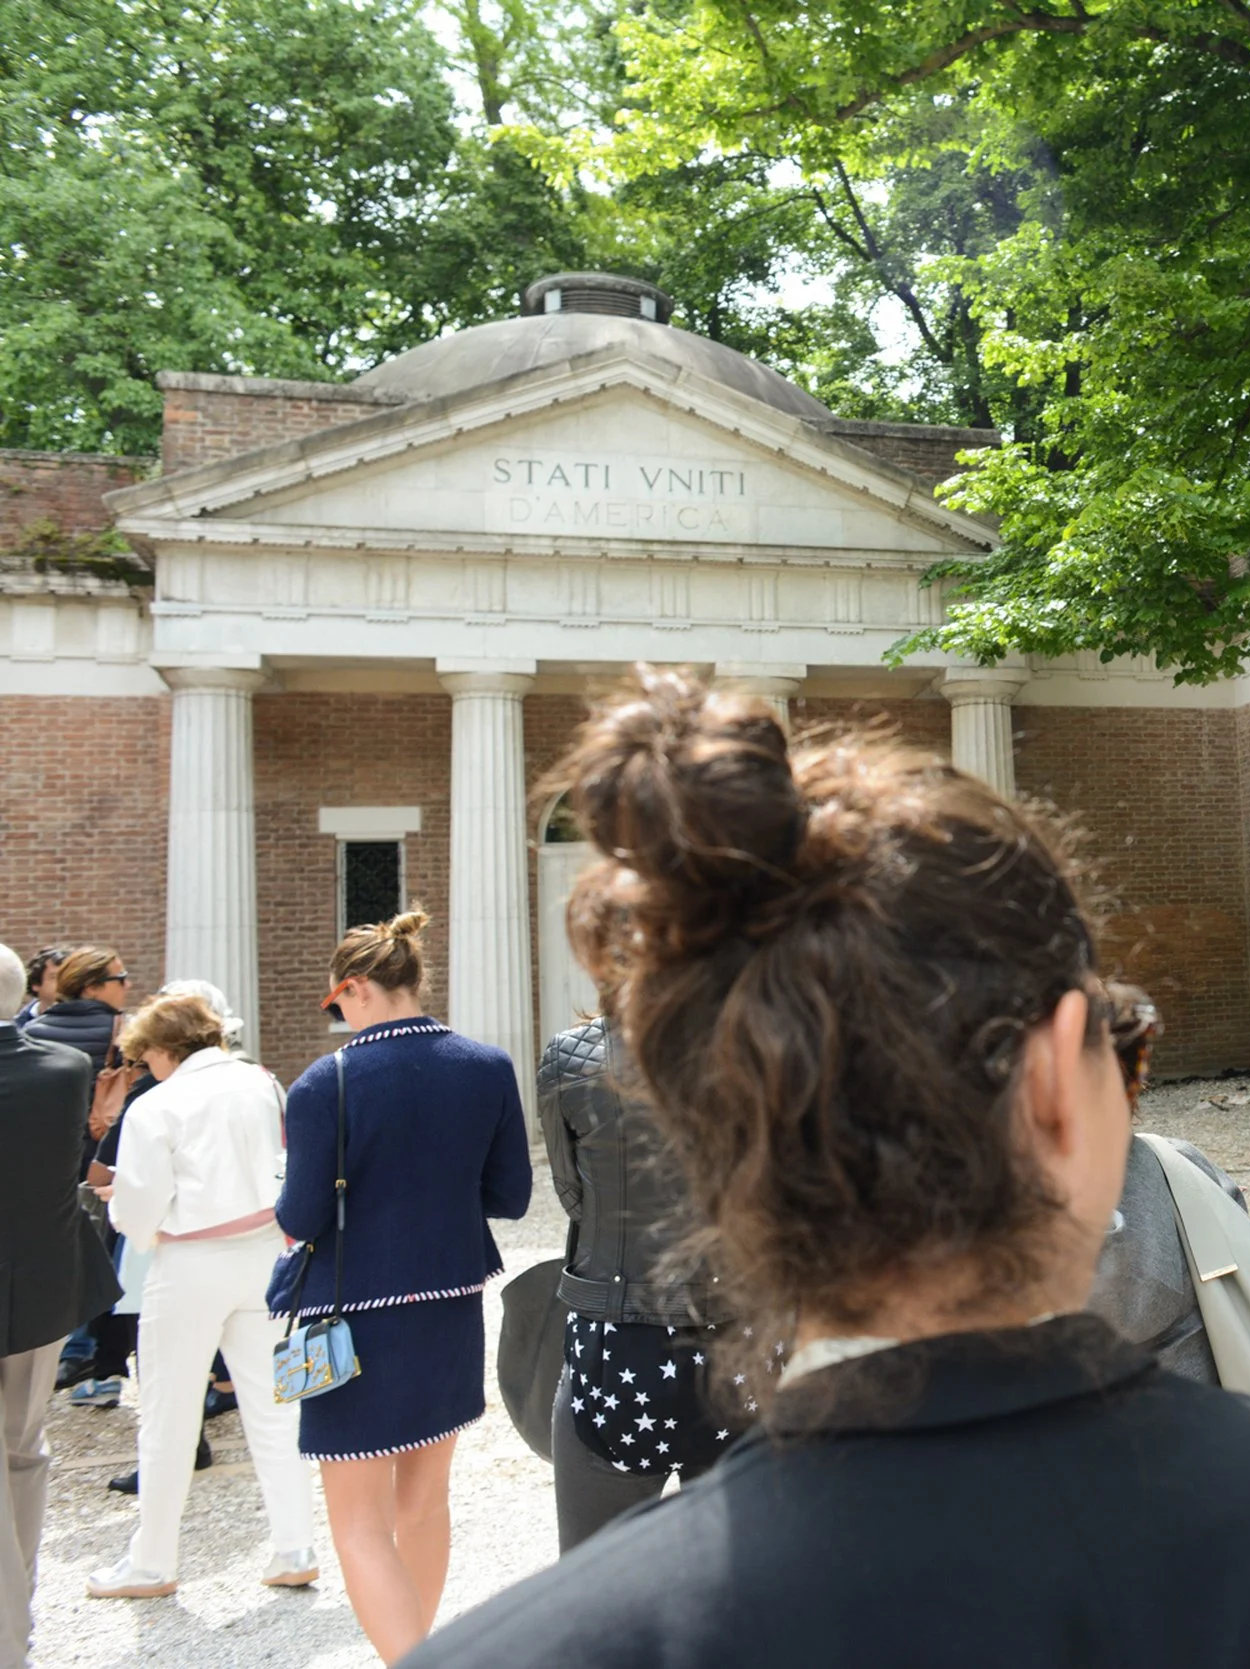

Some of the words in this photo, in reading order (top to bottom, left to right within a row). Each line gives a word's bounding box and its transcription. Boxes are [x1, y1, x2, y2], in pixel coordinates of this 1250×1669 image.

[493, 458, 610, 490] STATI
[640, 466, 746, 496] VNITI
[509, 497, 729, 531] D'AMERICA
